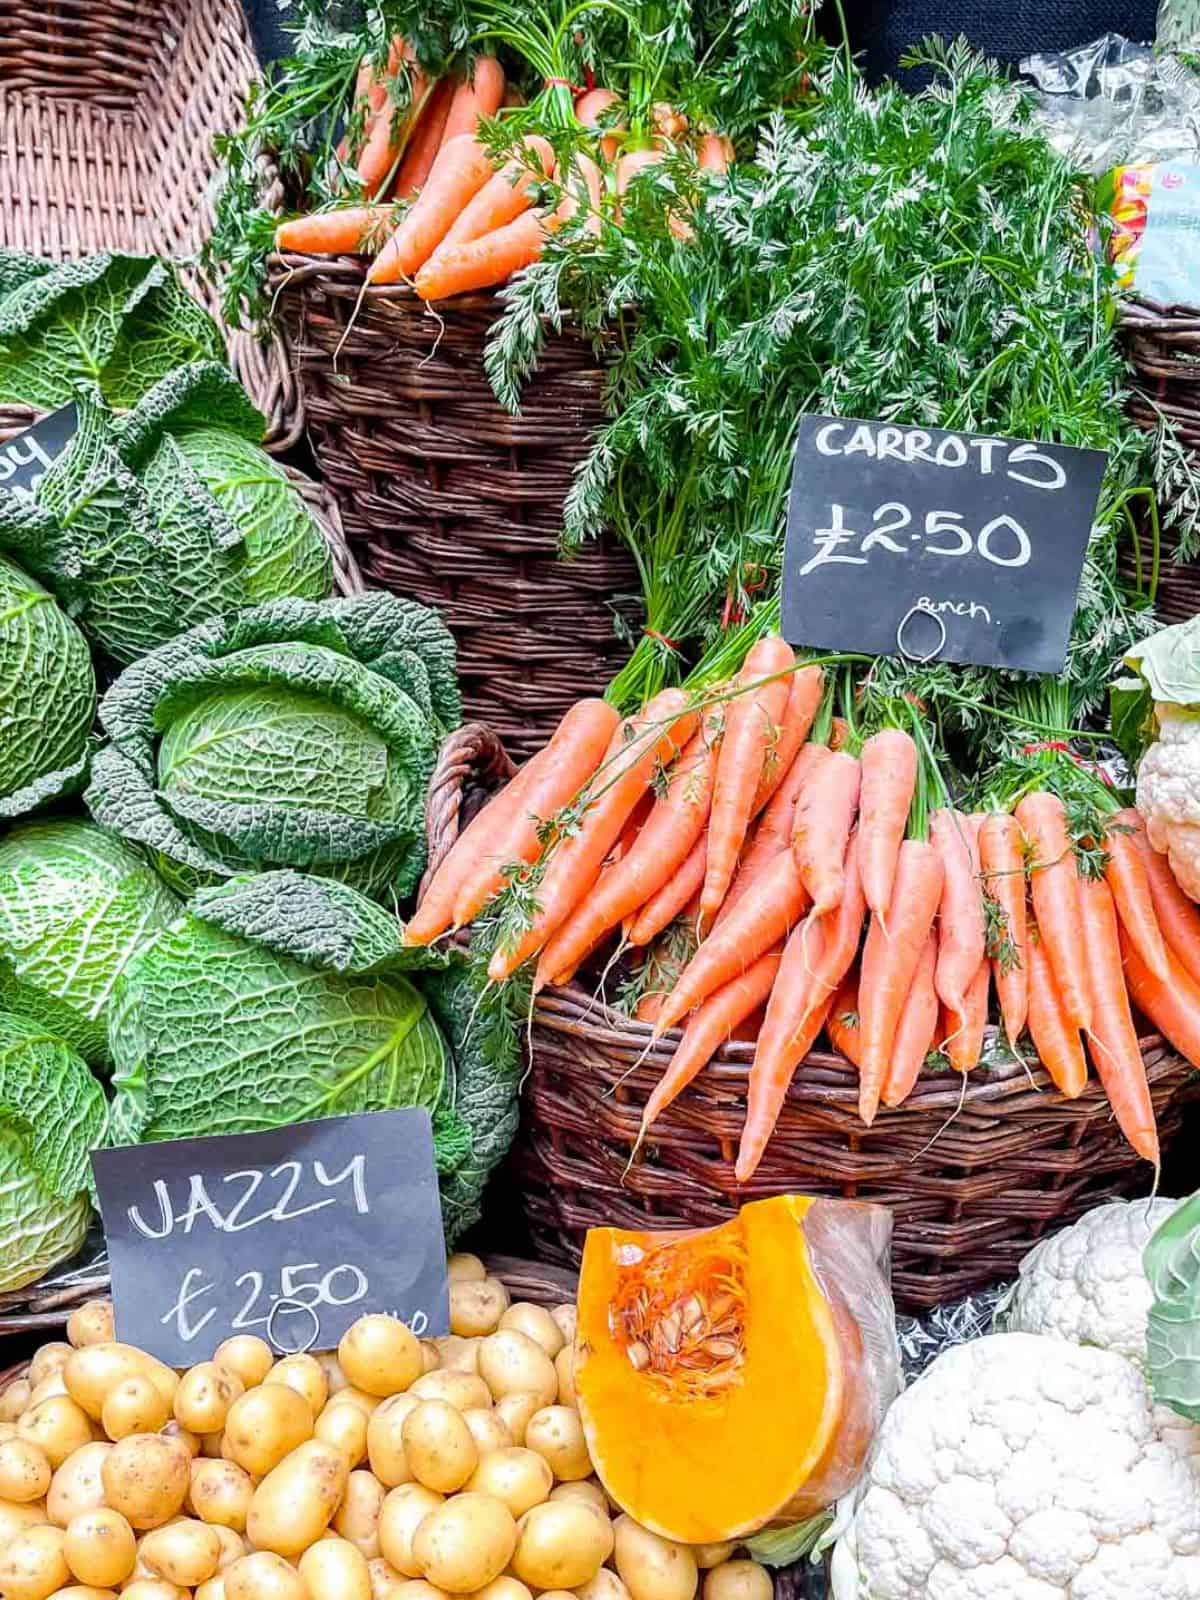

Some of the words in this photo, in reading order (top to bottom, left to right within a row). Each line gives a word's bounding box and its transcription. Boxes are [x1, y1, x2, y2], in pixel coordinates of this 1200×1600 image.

[815, 422, 1067, 490] CARROTS
[800, 502, 1032, 575] £2.50
[127, 1155, 370, 1239] JAZZY
